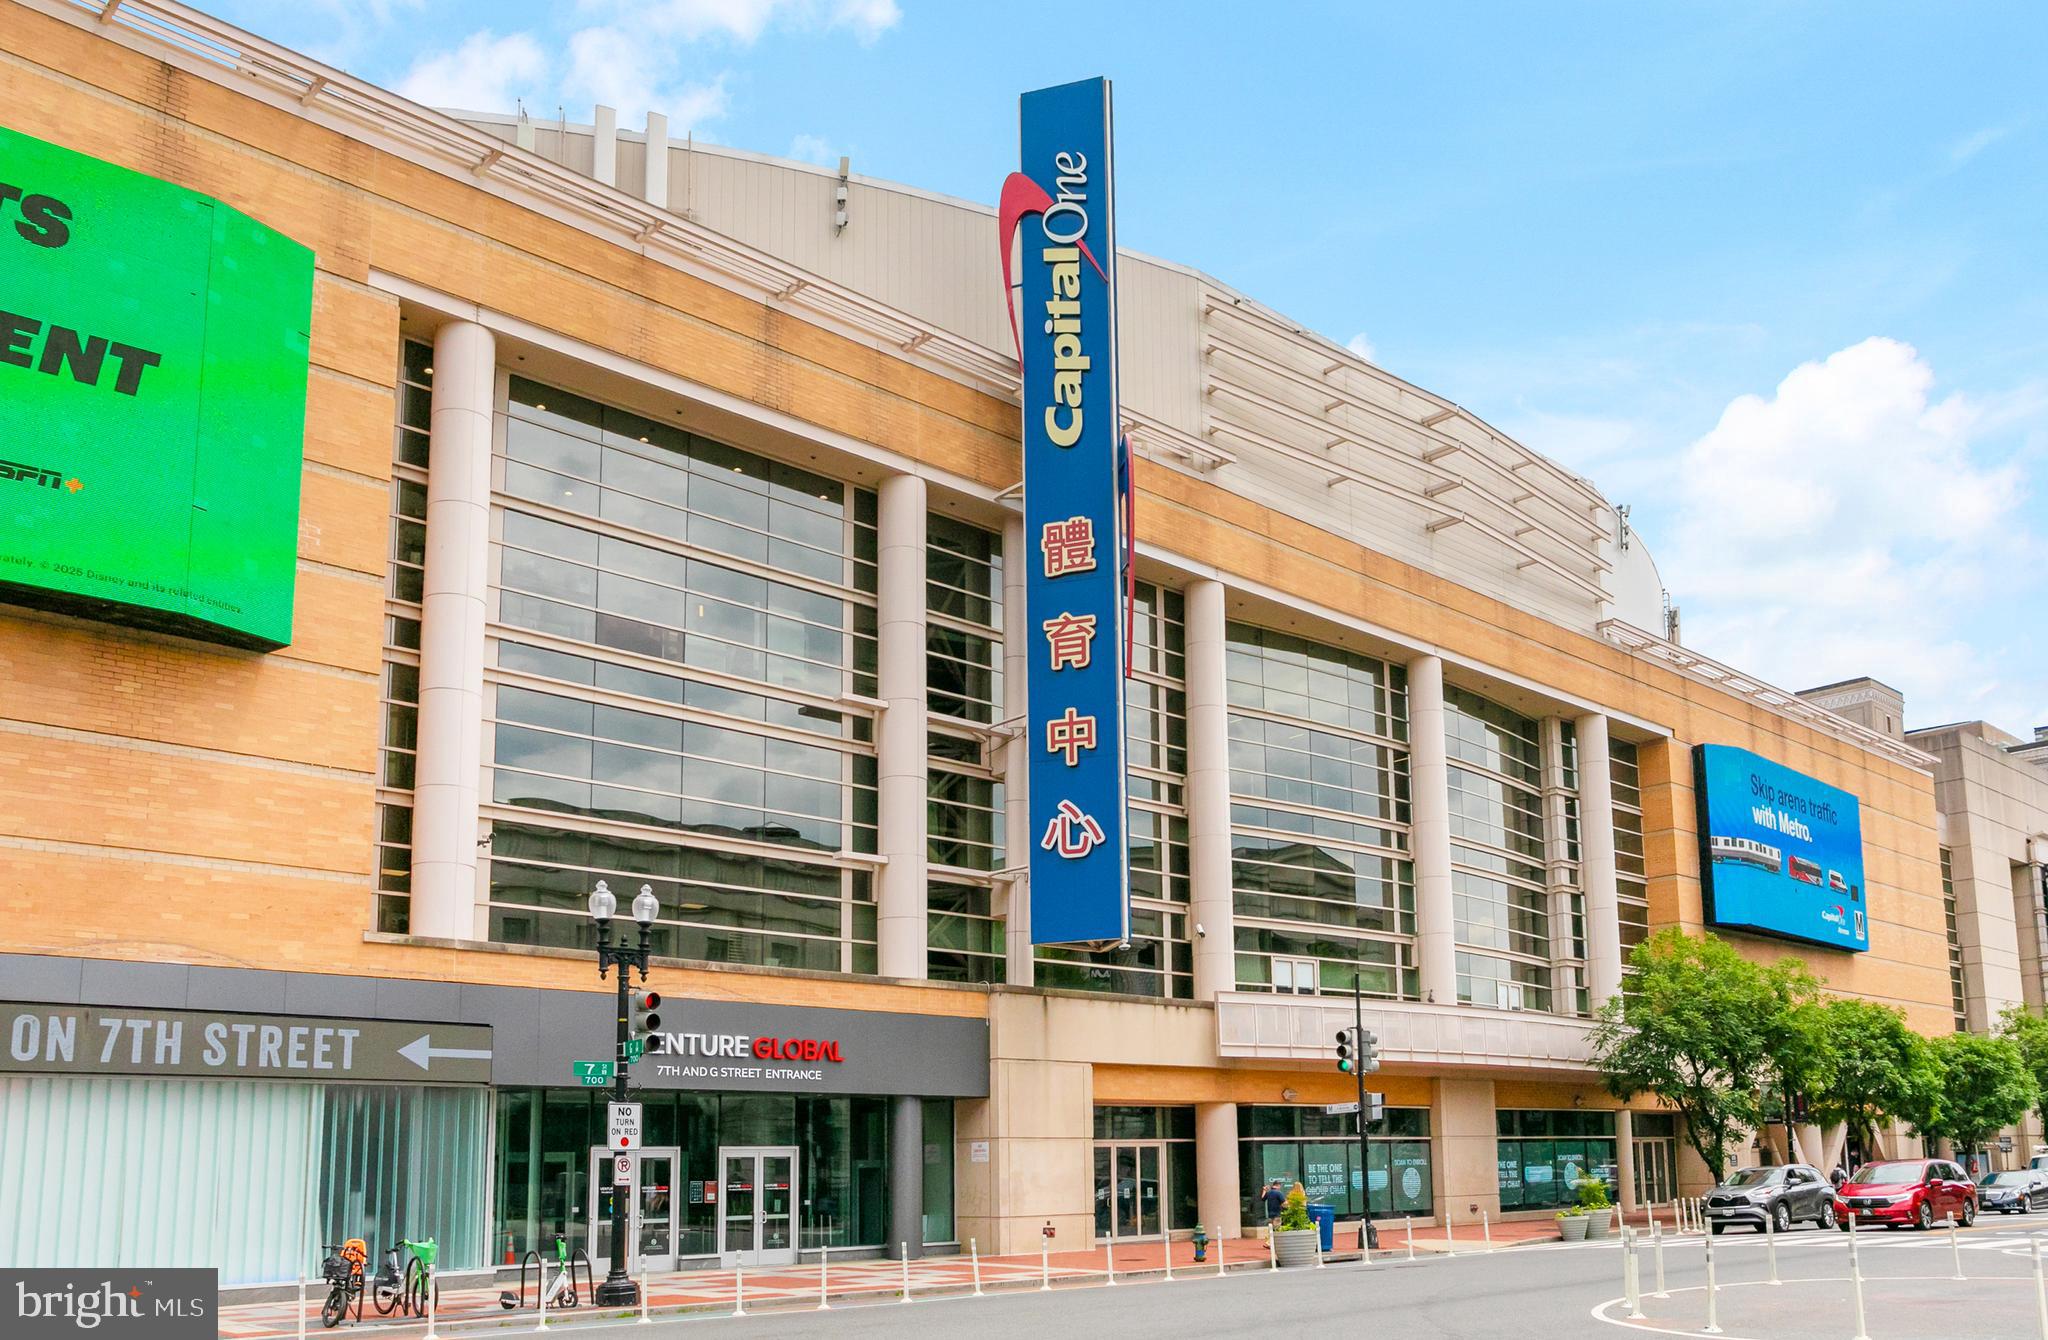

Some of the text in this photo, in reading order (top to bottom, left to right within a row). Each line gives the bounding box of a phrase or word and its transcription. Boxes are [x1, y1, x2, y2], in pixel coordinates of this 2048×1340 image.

[1041, 150, 1091, 448] Capital One
[53, 562, 84, 577] 2025
[86, 569, 124, 586] Disney
[127, 578, 149, 590] and
[1041, 516, 1106, 859] 體育中心
[1750, 773, 1838, 826] Skip arena traffic
[1752, 804, 1813, 843] with Metro.
[10, 1013, 361, 1071] ON 7TH STREET
[753, 1036, 845, 1062] GLOBAL
[584, 1063, 596, 1075] 7
[656, 1065, 822, 1081] 7TH AND G STREET ENTRANCE
[585, 1076, 604, 1085] 700
[618, 1107, 632, 1117] NO
[616, 1118, 635, 1126] TURN
[611, 1128, 639, 1136] ON RED
[1308, 1163, 1343, 1173] BE THE ONE
[1308, 1174, 1344, 1184] TO TELL THE
